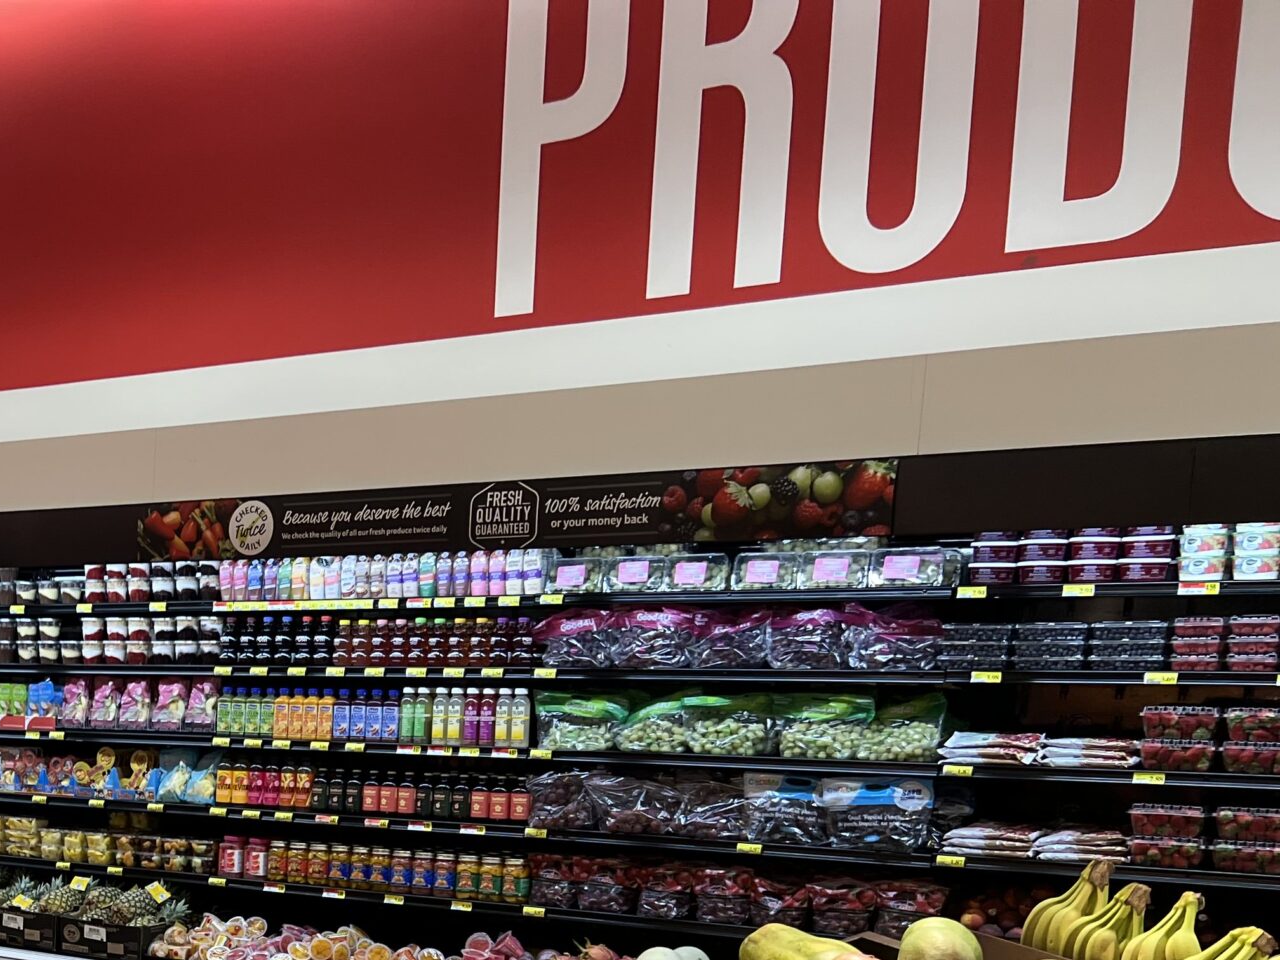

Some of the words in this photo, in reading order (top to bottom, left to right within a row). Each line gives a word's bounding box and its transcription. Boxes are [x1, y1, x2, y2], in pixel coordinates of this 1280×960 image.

[486, 490, 523, 507] FRESH
[544, 497, 580, 514] 100%
[584, 491, 661, 514] satisfaction
[235, 505, 268, 523] CHECKED
[282, 510, 329, 526] Because
[331, 513, 351, 530] you
[354, 504, 400, 522] deserve
[402, 501, 421, 519] the
[423, 500, 452, 518] best
[476, 506, 531, 523] QUALITY
[550, 519, 561, 528] or
[563, 517, 585, 530] your
[588, 515, 622, 528] money
[624, 513, 648, 525] back
[234, 523, 267, 539] Twice
[281, 532, 292, 540] We
[292, 532, 309, 540] check
[320, 530, 342, 539] quality
[369, 527, 386, 536] fresh
[386, 526, 413, 536] produce
[413, 526, 430, 534] twice
[431, 525, 448, 535] daily
[475, 522, 530, 536] GUARANTEED
[239, 539, 262, 550] DAILY
